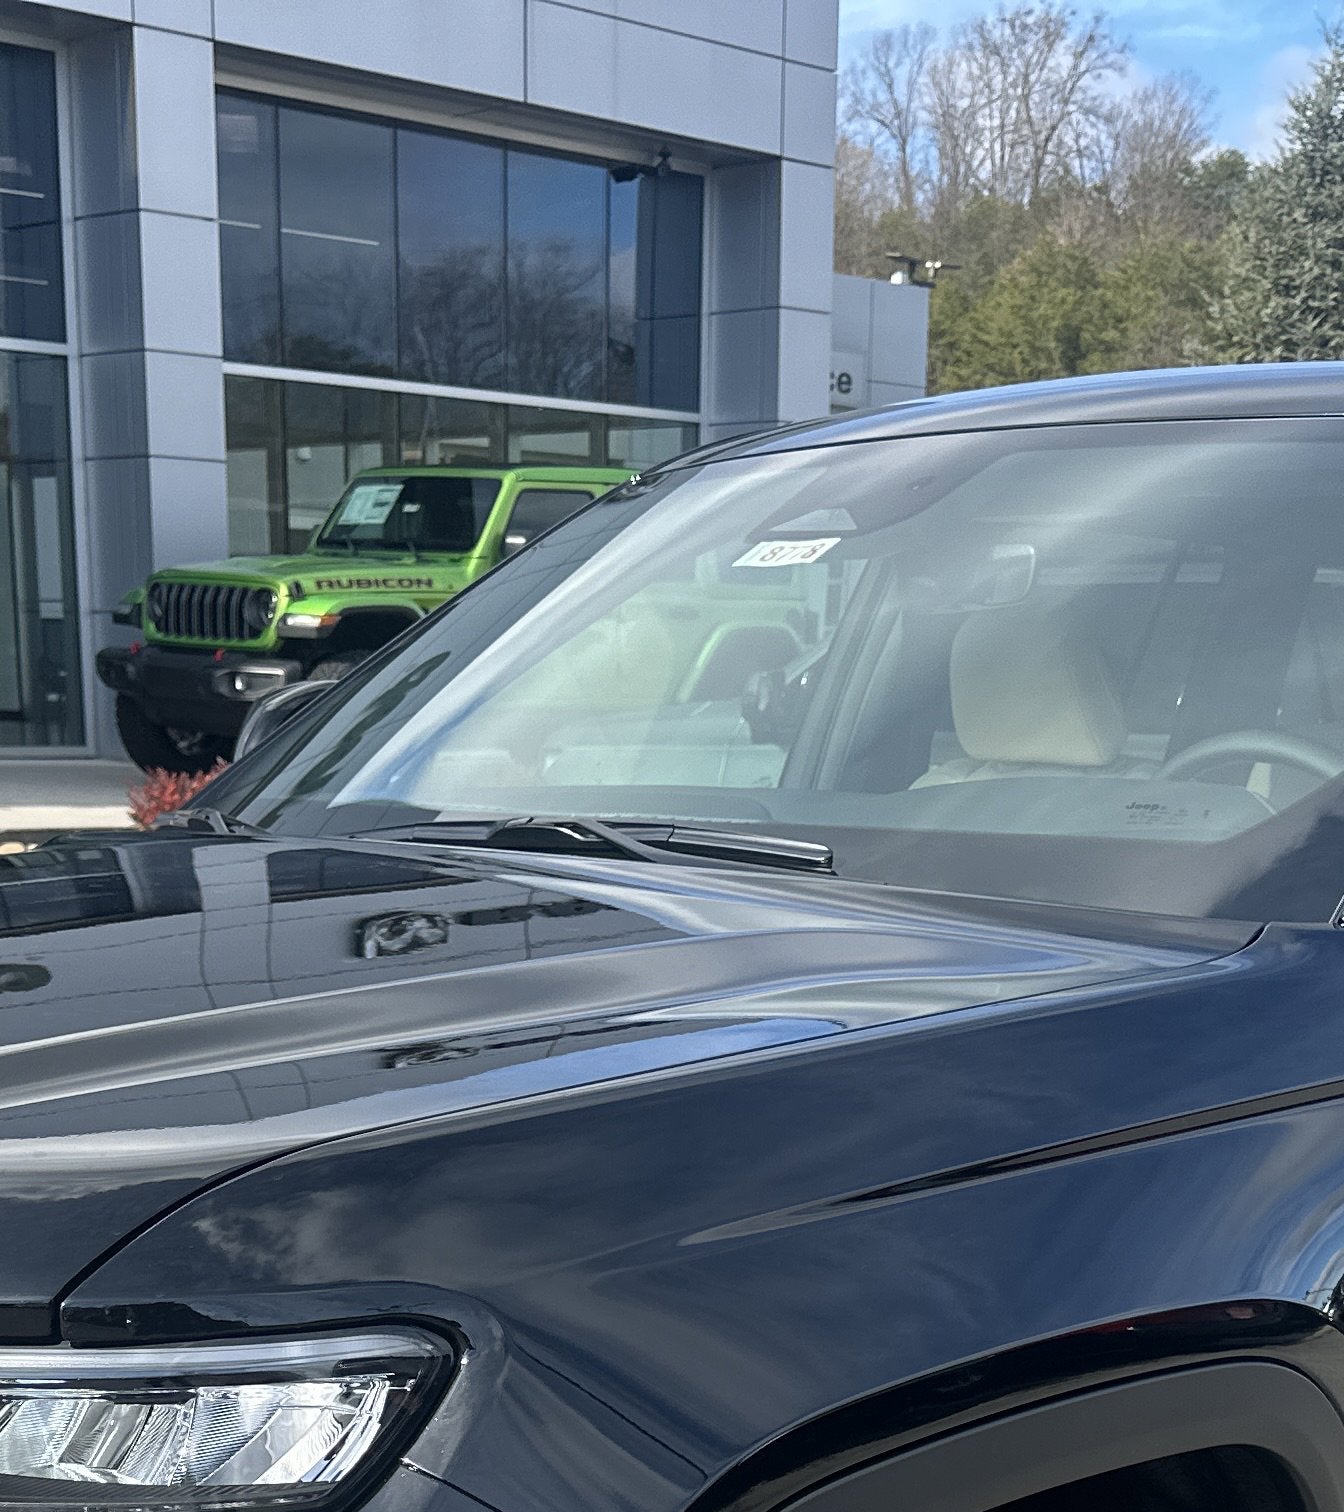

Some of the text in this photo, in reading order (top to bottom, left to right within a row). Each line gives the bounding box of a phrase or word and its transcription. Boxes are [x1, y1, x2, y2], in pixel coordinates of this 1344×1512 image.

[758, 542, 827, 562] 8778
[316, 577, 434, 591] RUBICON
[1125, 801, 1160, 812] Jeep
